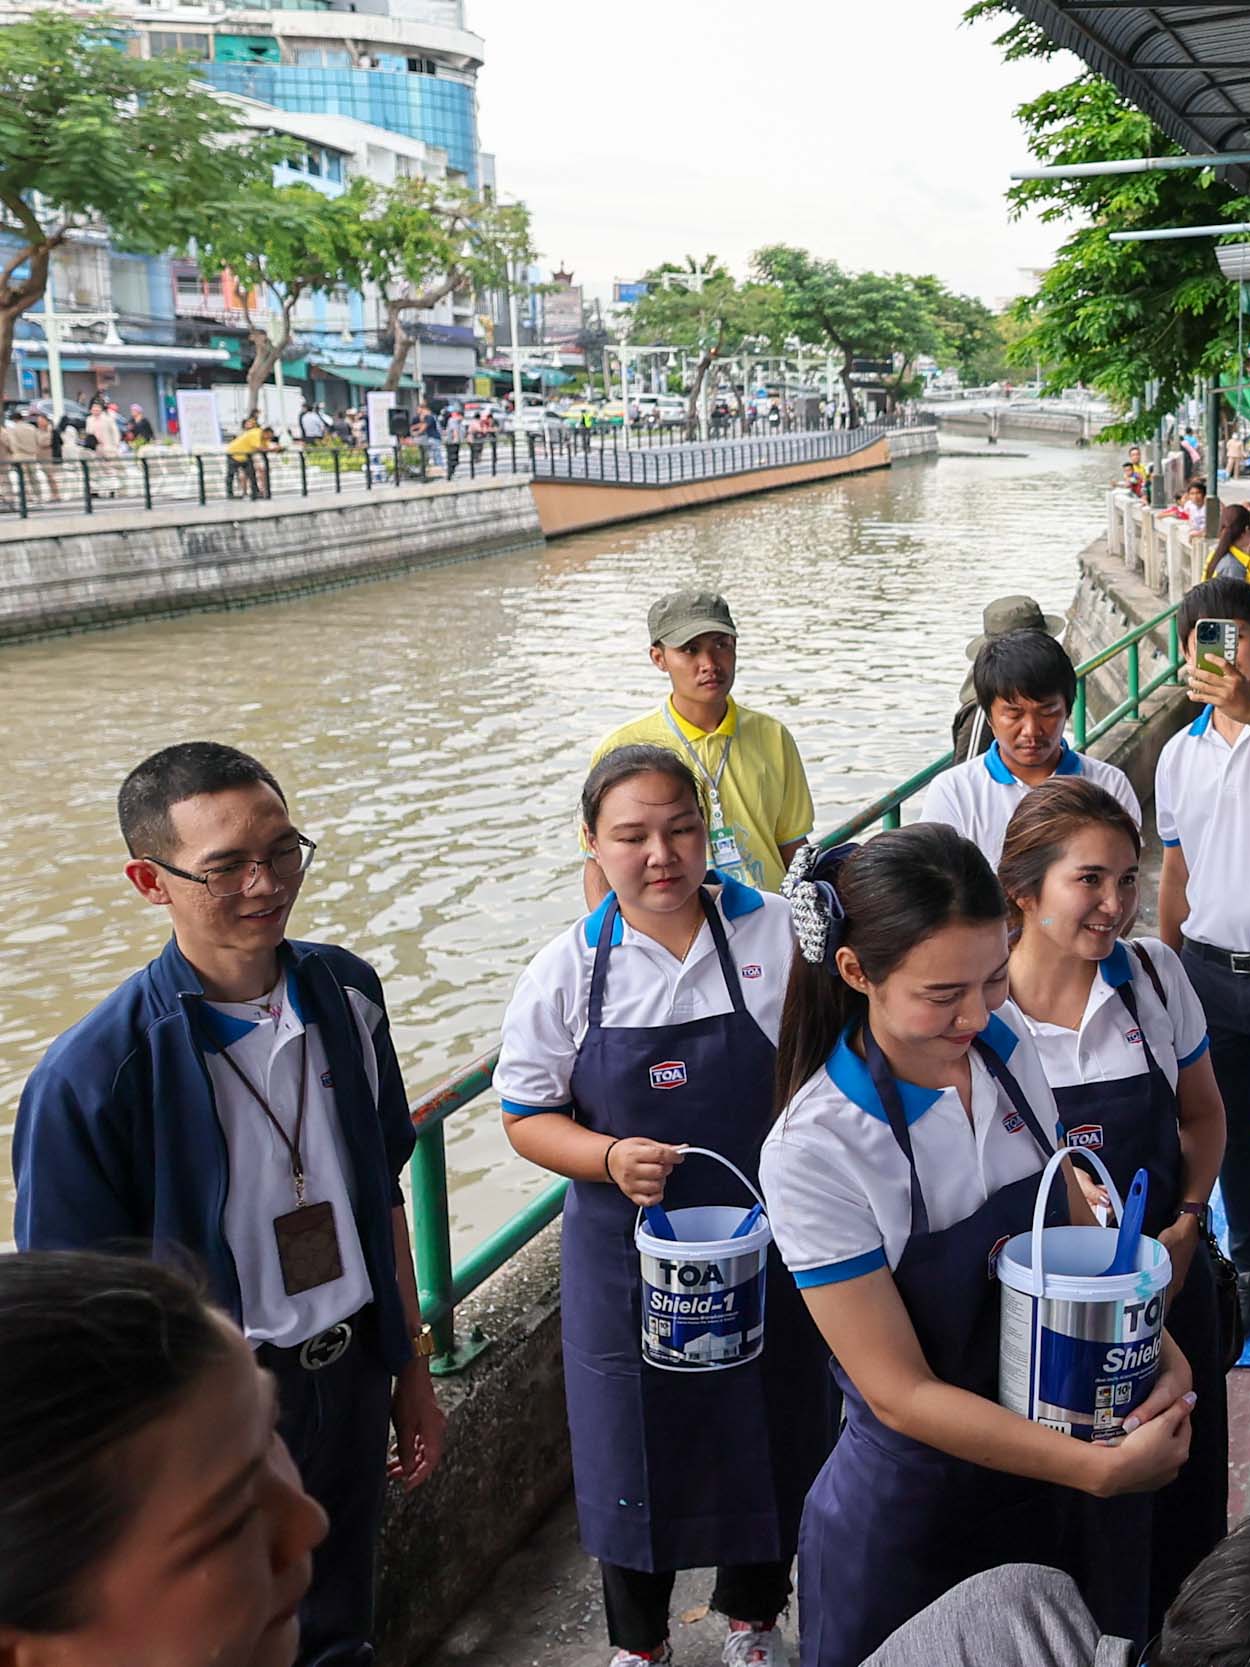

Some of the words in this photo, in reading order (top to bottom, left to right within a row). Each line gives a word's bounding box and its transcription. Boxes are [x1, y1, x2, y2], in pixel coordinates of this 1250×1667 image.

[1224, 624, 1236, 665] GKIT
[743, 968, 761, 976] TOA
[653, 1069, 683, 1082] TOA
[1070, 1133, 1099, 1147] TOA
[660, 1262, 724, 1287] TOA
[650, 1291, 735, 1314] Shield-1
